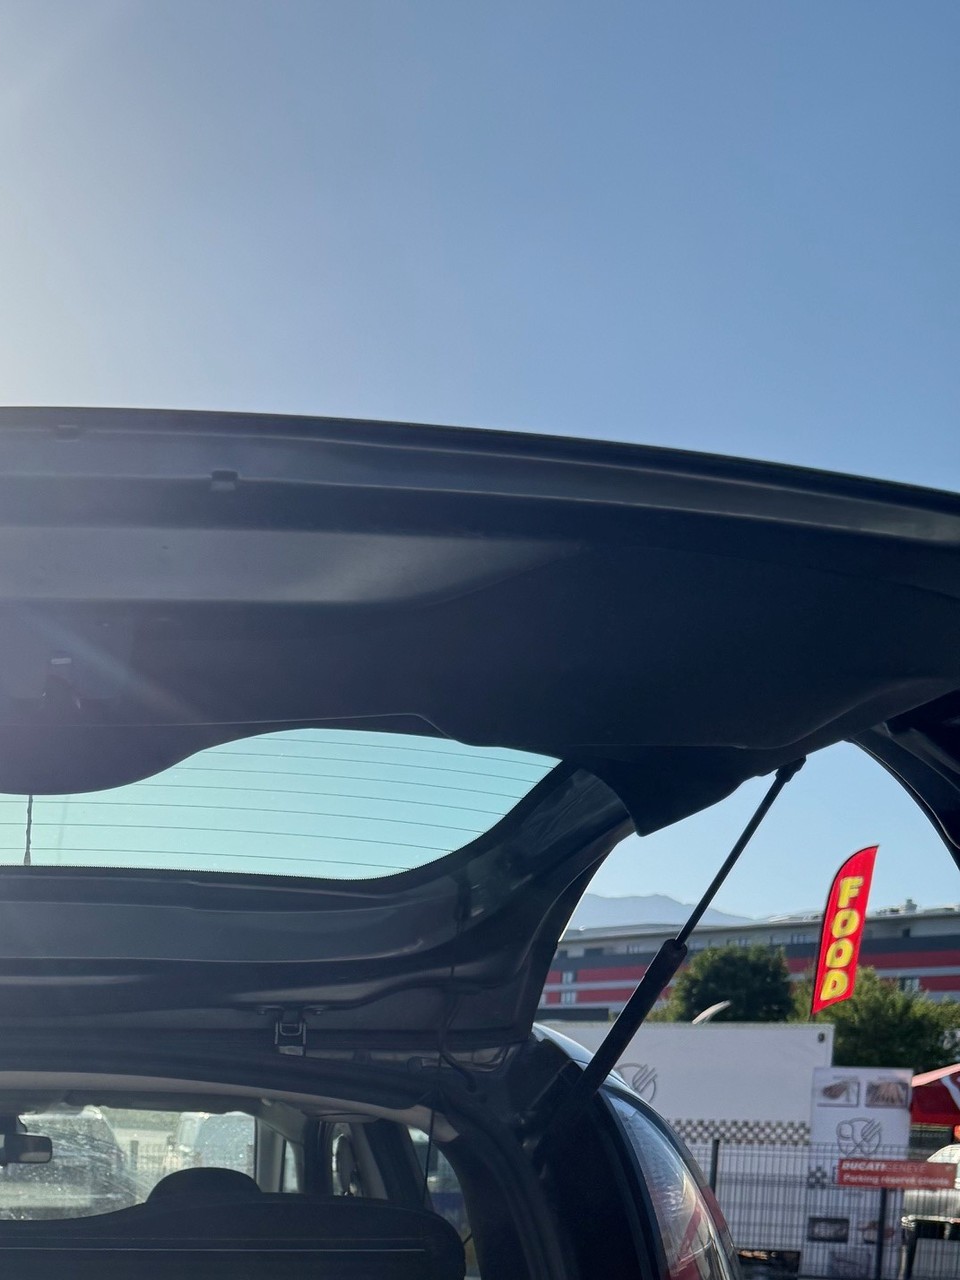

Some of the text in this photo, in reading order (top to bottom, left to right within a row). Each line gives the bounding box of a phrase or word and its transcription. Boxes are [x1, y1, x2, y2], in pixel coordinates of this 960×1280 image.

[819, 876, 865, 1001] FOOD
[842, 1161, 886, 1171] DUCATI
[843, 1173, 880, 1185] Parking
